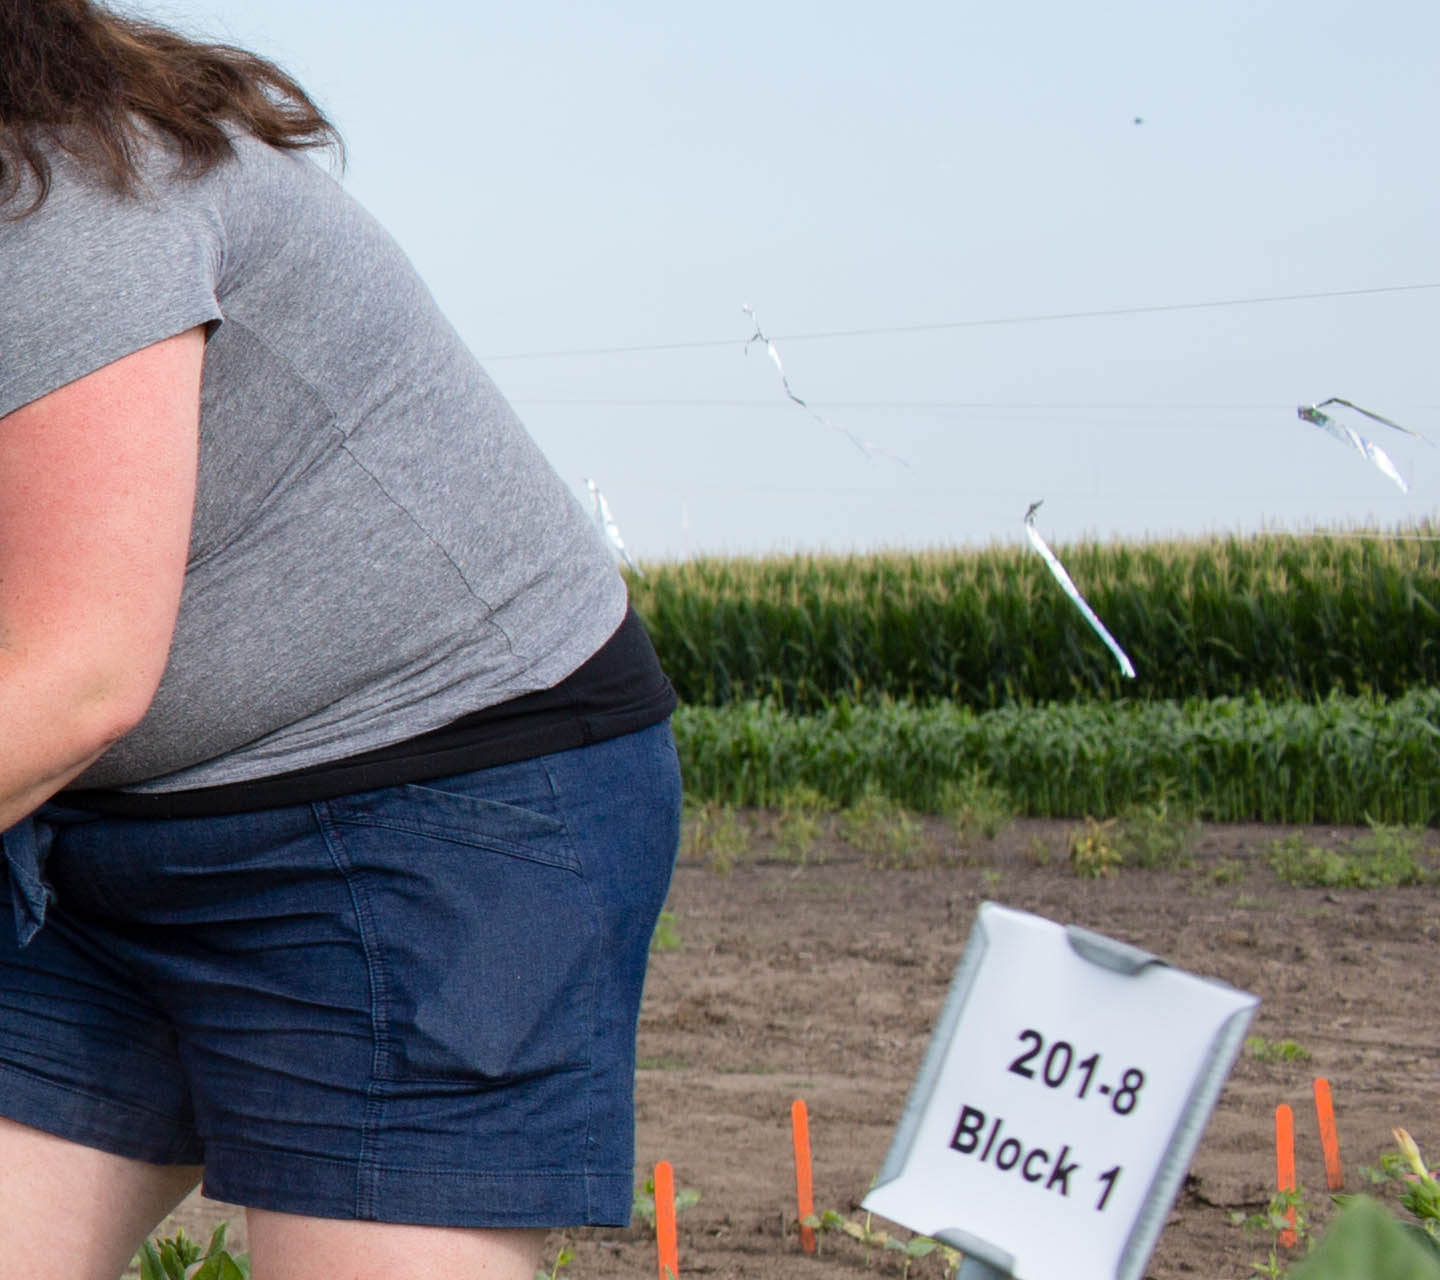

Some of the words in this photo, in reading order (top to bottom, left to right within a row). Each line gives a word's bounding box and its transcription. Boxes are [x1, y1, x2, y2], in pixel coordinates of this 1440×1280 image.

[1007, 1028, 1146, 1116] 201-8
[949, 1104, 1079, 1197] Block
[1094, 1165, 1122, 1211] 1
